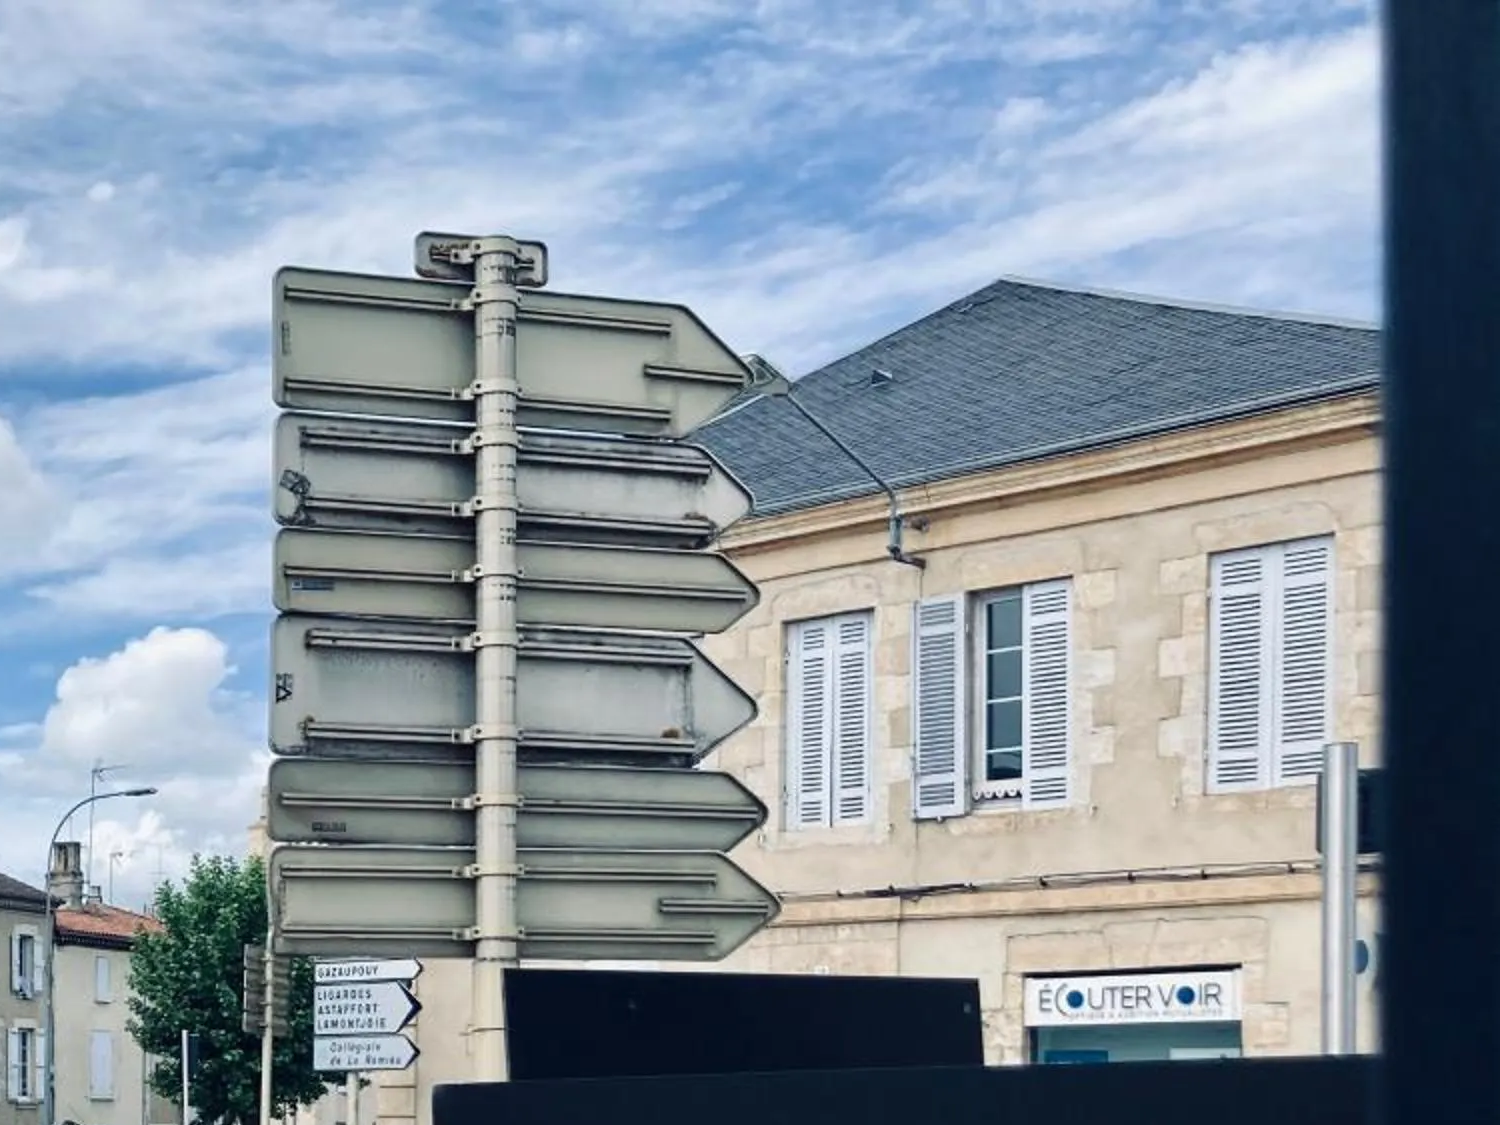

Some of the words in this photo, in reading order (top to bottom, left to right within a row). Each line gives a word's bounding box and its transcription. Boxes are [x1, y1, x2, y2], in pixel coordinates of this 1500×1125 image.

[317, 966, 379, 978] GAZAUPOUY
[317, 988, 372, 1000] LIGARDES
[1038, 983, 1152, 1016] ÉCOUTER
[1157, 983, 1222, 1006] VOIR
[317, 1003, 378, 1014] ASTAFFORT
[317, 1018, 387, 1030] LAMONTJOIE
